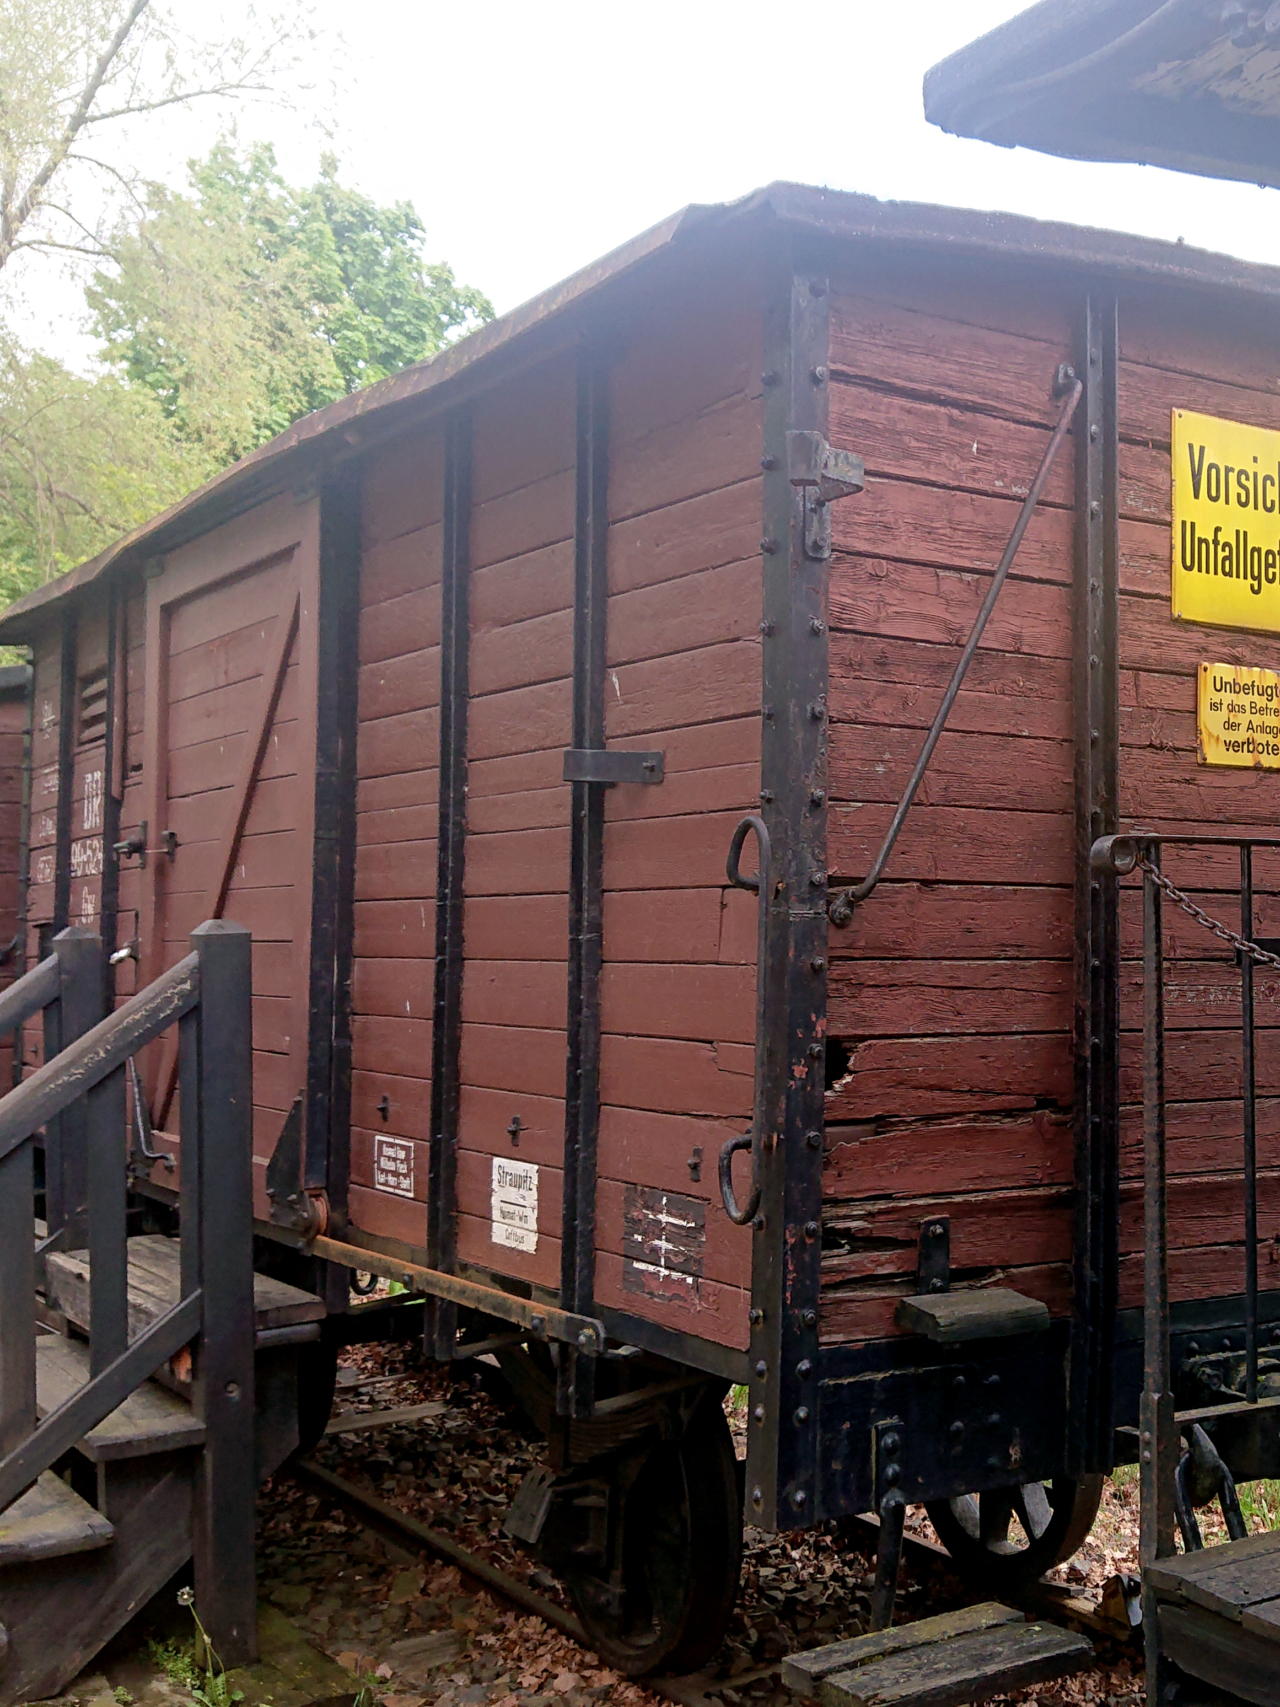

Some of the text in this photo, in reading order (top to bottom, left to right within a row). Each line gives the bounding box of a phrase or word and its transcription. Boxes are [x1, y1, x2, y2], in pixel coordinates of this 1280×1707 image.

[1209, 698, 1224, 713] ist
[1226, 699, 1247, 715] das
[1223, 716, 1242, 732] der
[497, 1164, 533, 1192] Straupitz
